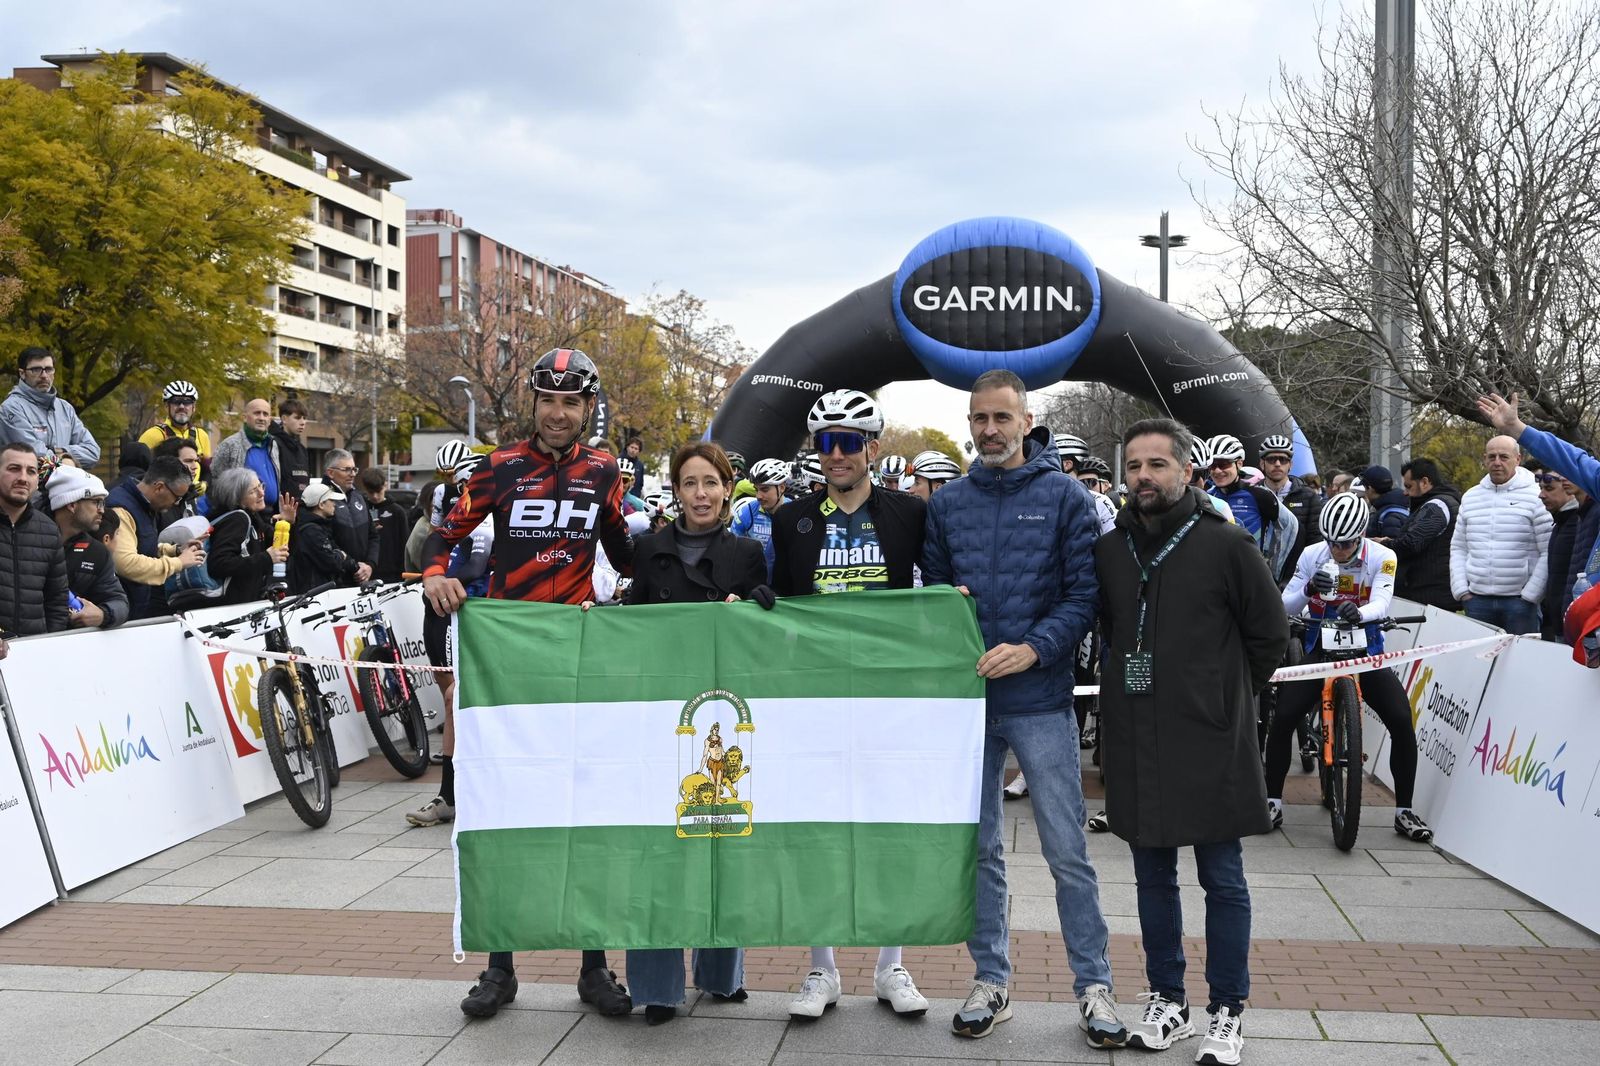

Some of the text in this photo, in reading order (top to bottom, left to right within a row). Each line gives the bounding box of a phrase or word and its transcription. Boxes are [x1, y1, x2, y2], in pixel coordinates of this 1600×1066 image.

[913, 285, 1073, 312] GARMIN
[751, 374, 823, 392] garmin.com
[1172, 371, 1249, 394] garmin.com
[509, 499, 600, 530] BH
[509, 530, 592, 540] COLOMA TEAM
[351, 597, 374, 616] 15-1
[250, 616, 271, 634] 9-2
[1333, 630, 1354, 646] 4-1
[1427, 681, 1470, 736] Diputación
[38, 712, 161, 792] Andalucía
[1425, 728, 1457, 777] Córdoba
[1469, 717, 1567, 808] Andalucía
[693, 816, 710, 824] PARA
